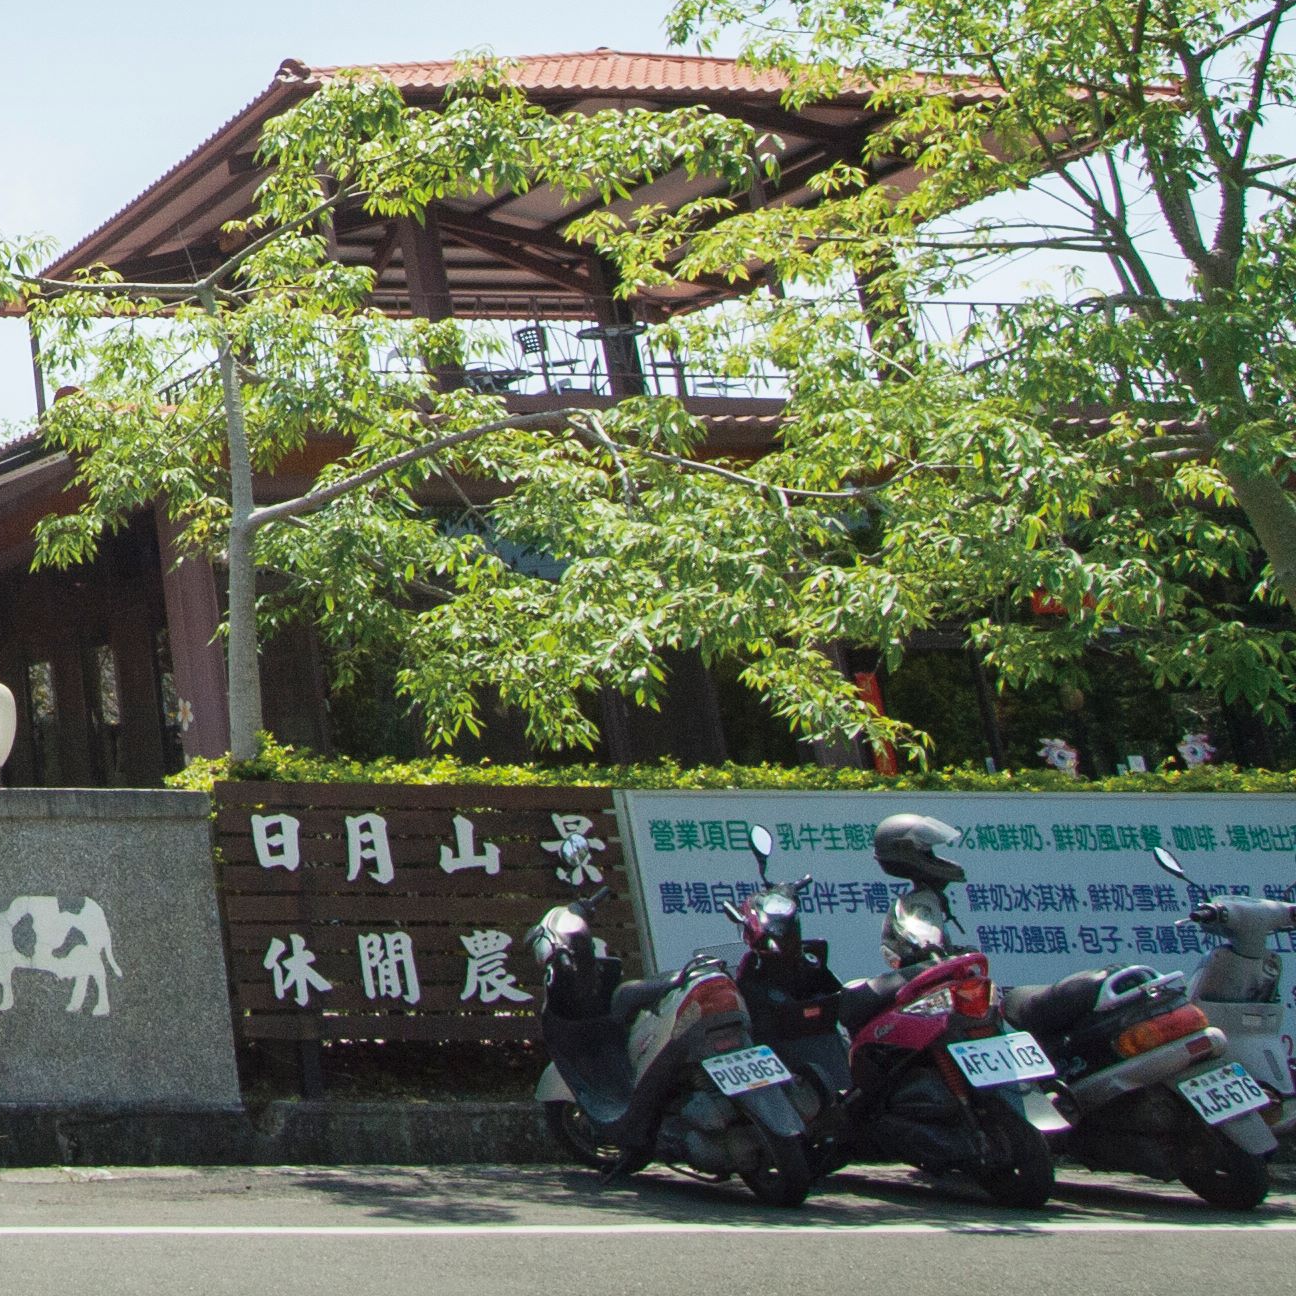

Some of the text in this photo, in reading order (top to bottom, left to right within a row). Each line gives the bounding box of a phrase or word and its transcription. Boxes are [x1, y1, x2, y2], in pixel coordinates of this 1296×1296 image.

[251, 812, 606, 885] 日月山景
[649, 819, 751, 852] 營業項目
[263, 930, 608, 1006] 休閒農
